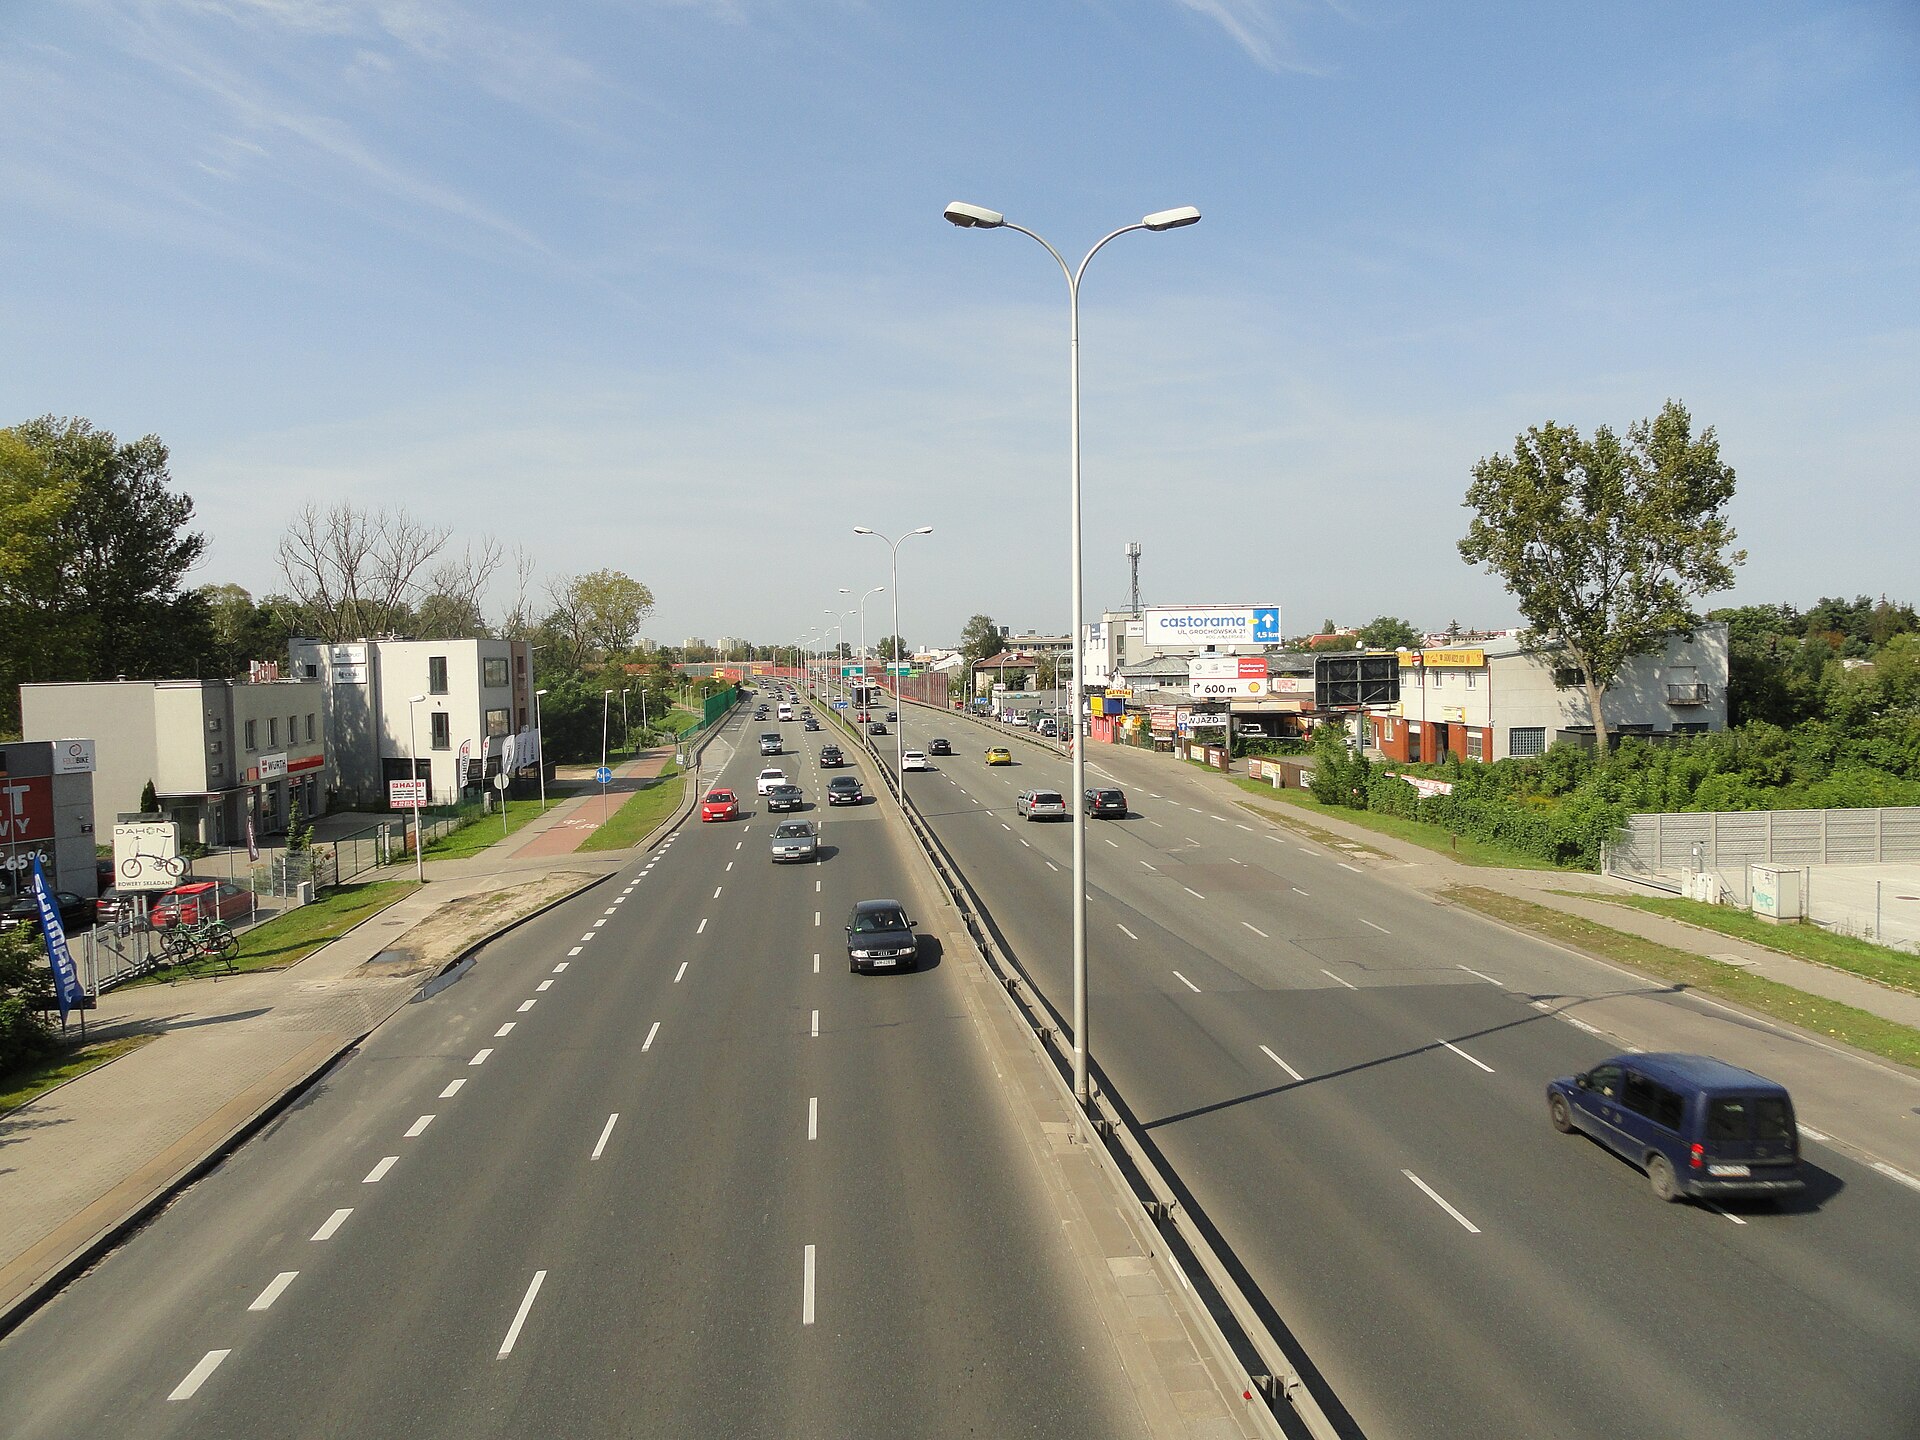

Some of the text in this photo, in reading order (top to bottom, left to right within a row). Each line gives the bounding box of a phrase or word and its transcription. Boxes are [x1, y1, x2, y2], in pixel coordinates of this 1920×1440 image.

[1160, 616, 1246, 628] castorama
[1204, 684, 1226, 694] 600
[115, 826, 166, 835] DAHON
